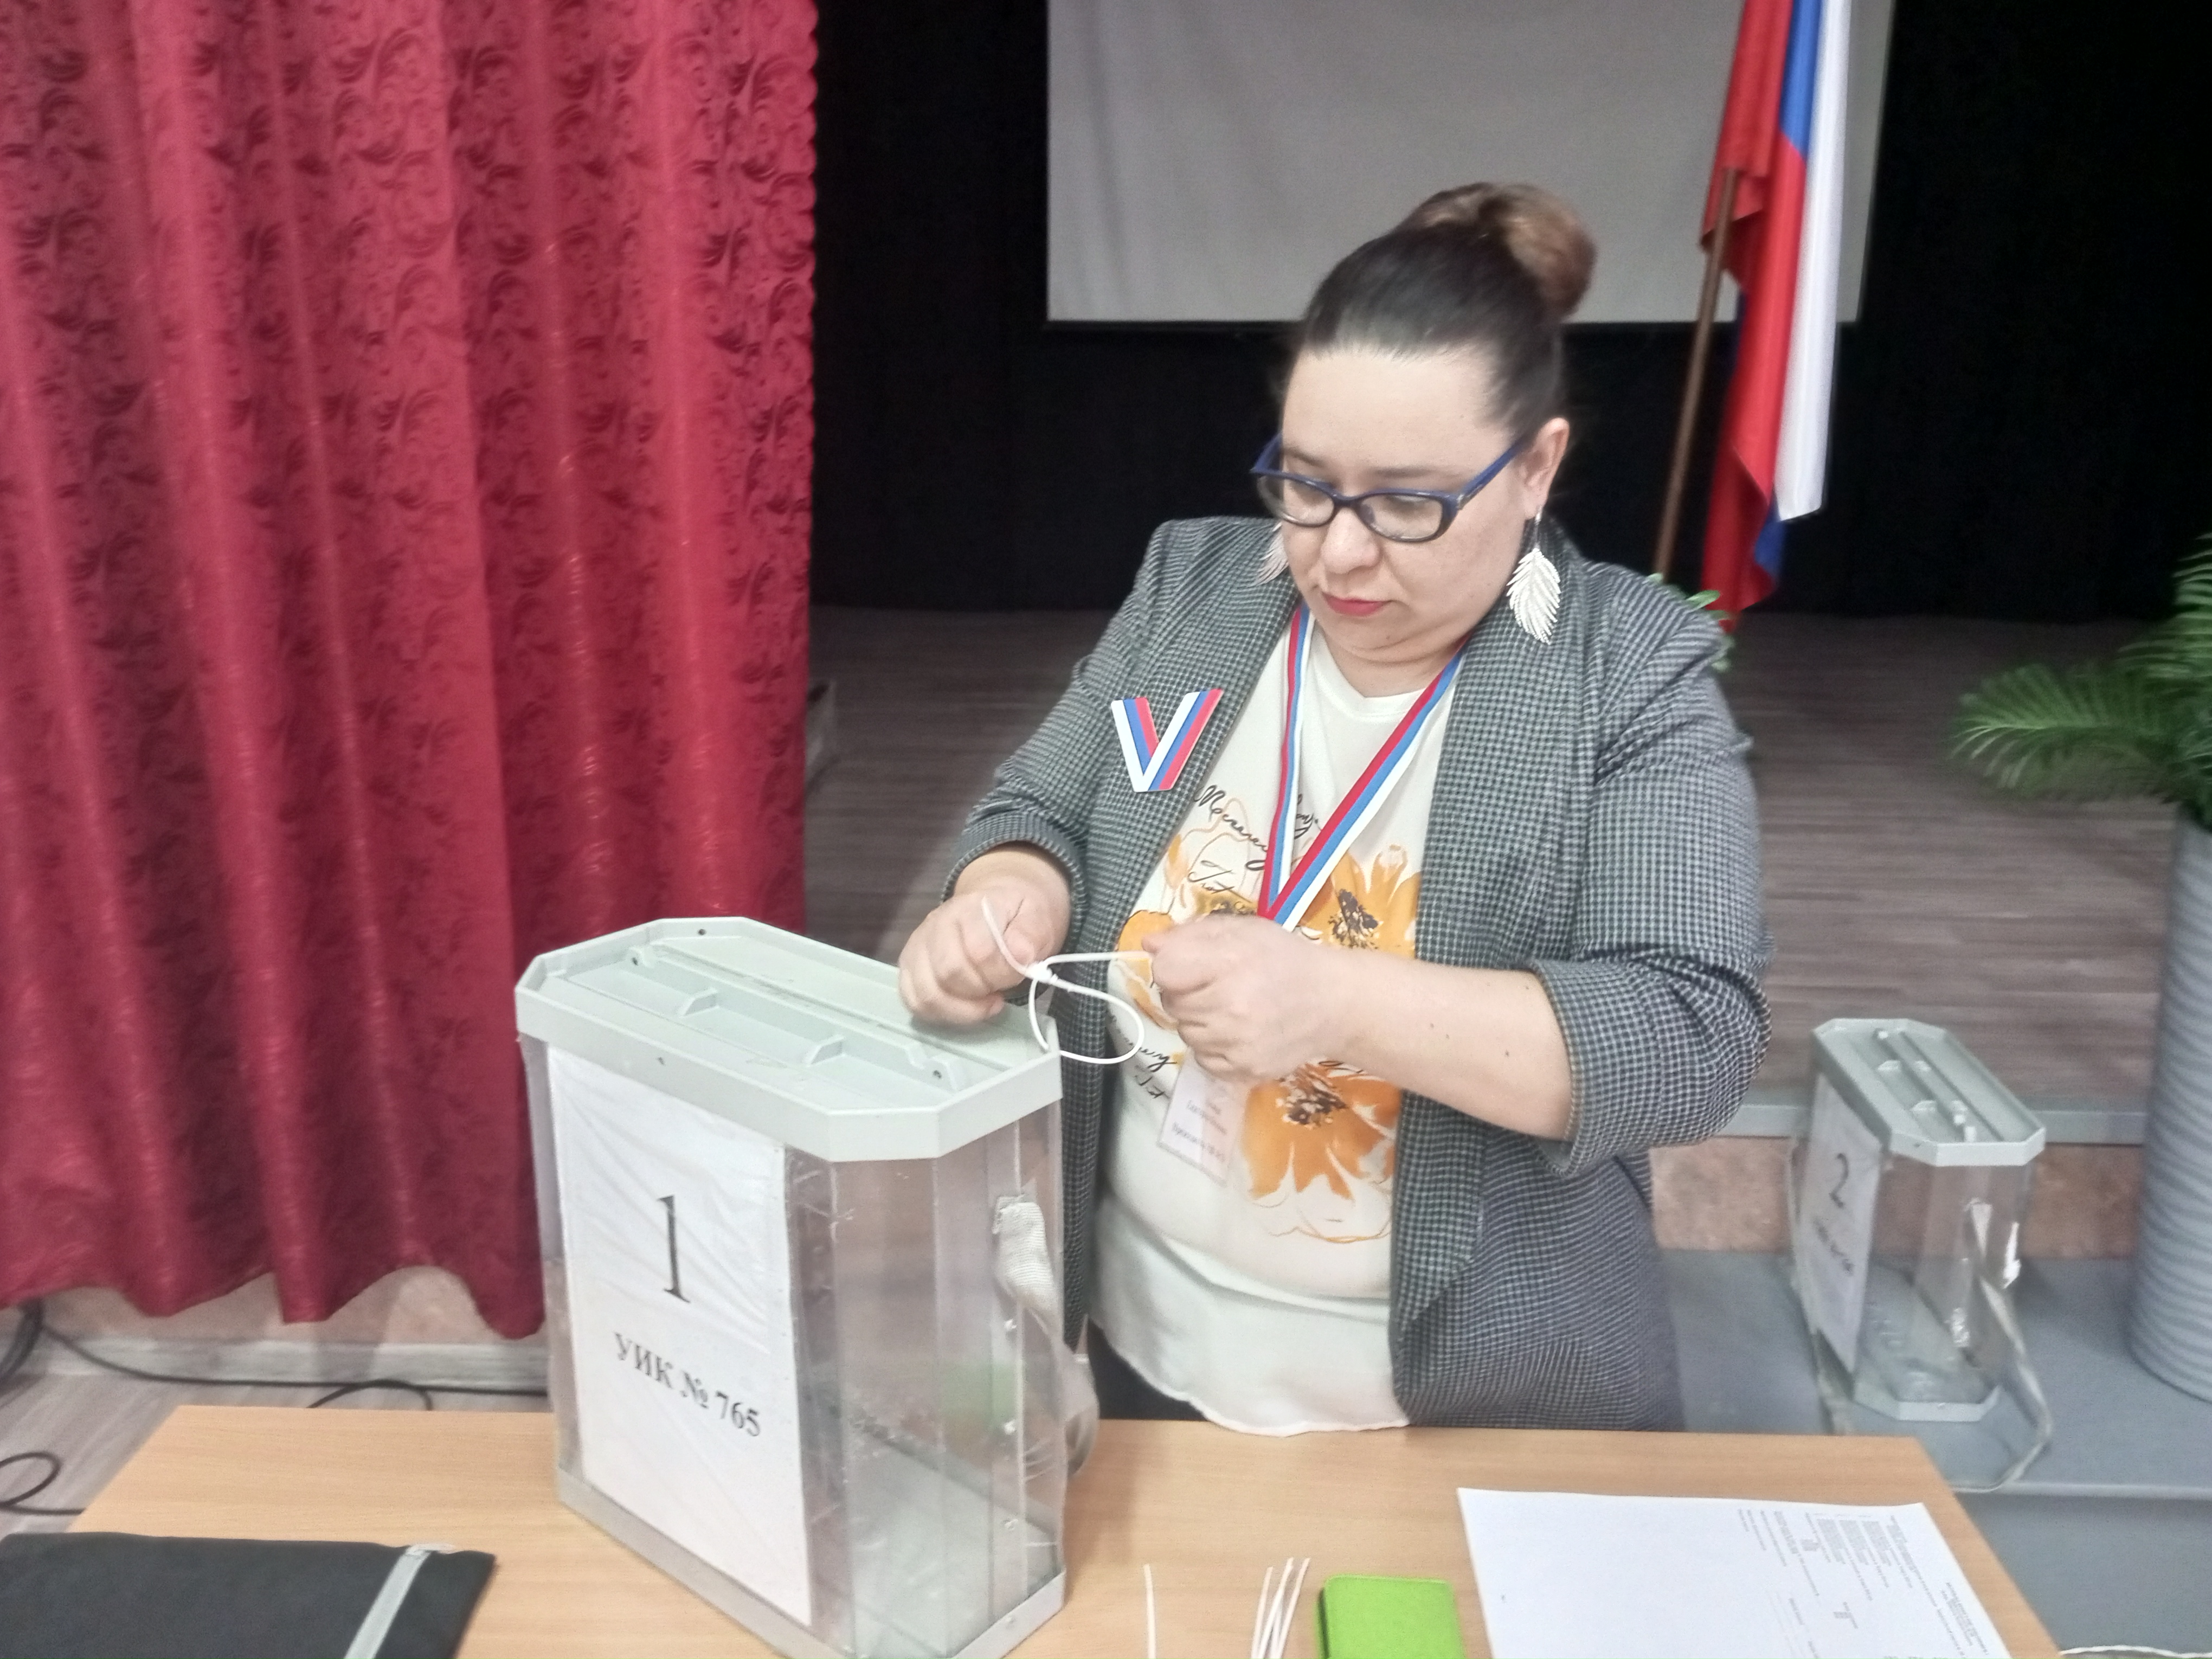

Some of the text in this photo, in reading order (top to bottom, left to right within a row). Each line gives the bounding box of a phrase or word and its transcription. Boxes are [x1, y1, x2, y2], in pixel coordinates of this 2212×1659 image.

[1829, 1152, 1851, 1210] 2
[657, 1194, 691, 1303] 1
[614, 1332, 760, 1437] УИК № 765
